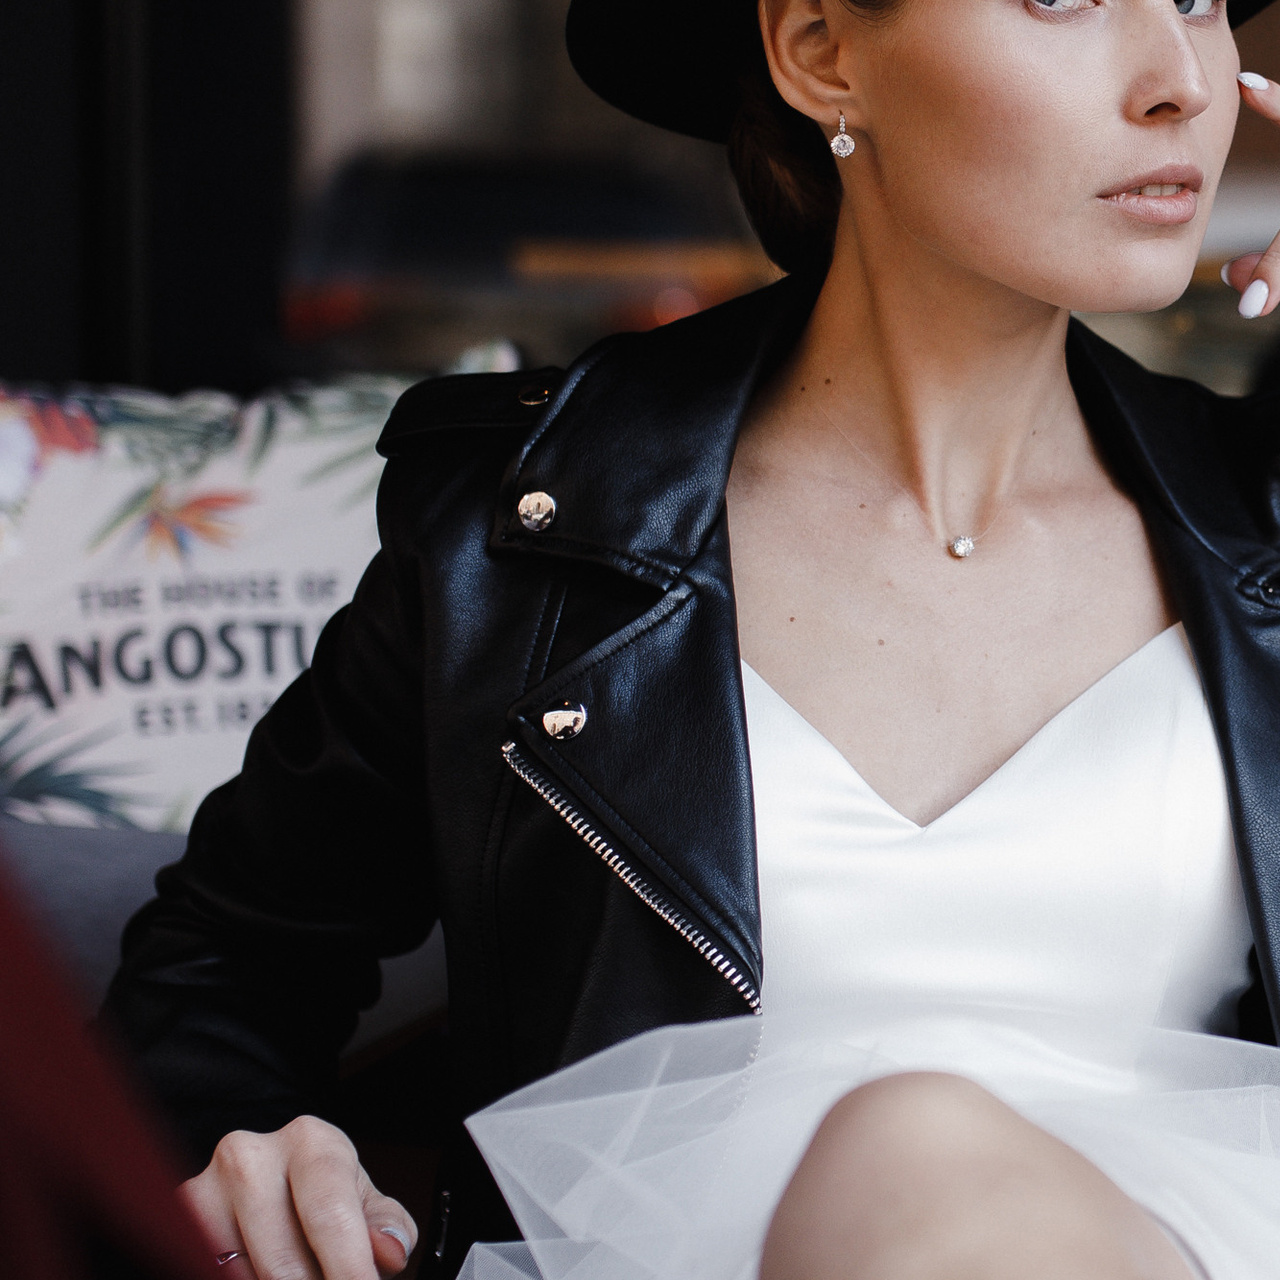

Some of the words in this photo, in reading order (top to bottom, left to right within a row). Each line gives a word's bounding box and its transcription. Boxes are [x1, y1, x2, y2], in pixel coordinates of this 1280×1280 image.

[79, 582, 143, 611] THE
[161, 575, 282, 605] HOUSE
[297, 572, 338, 601] OF
